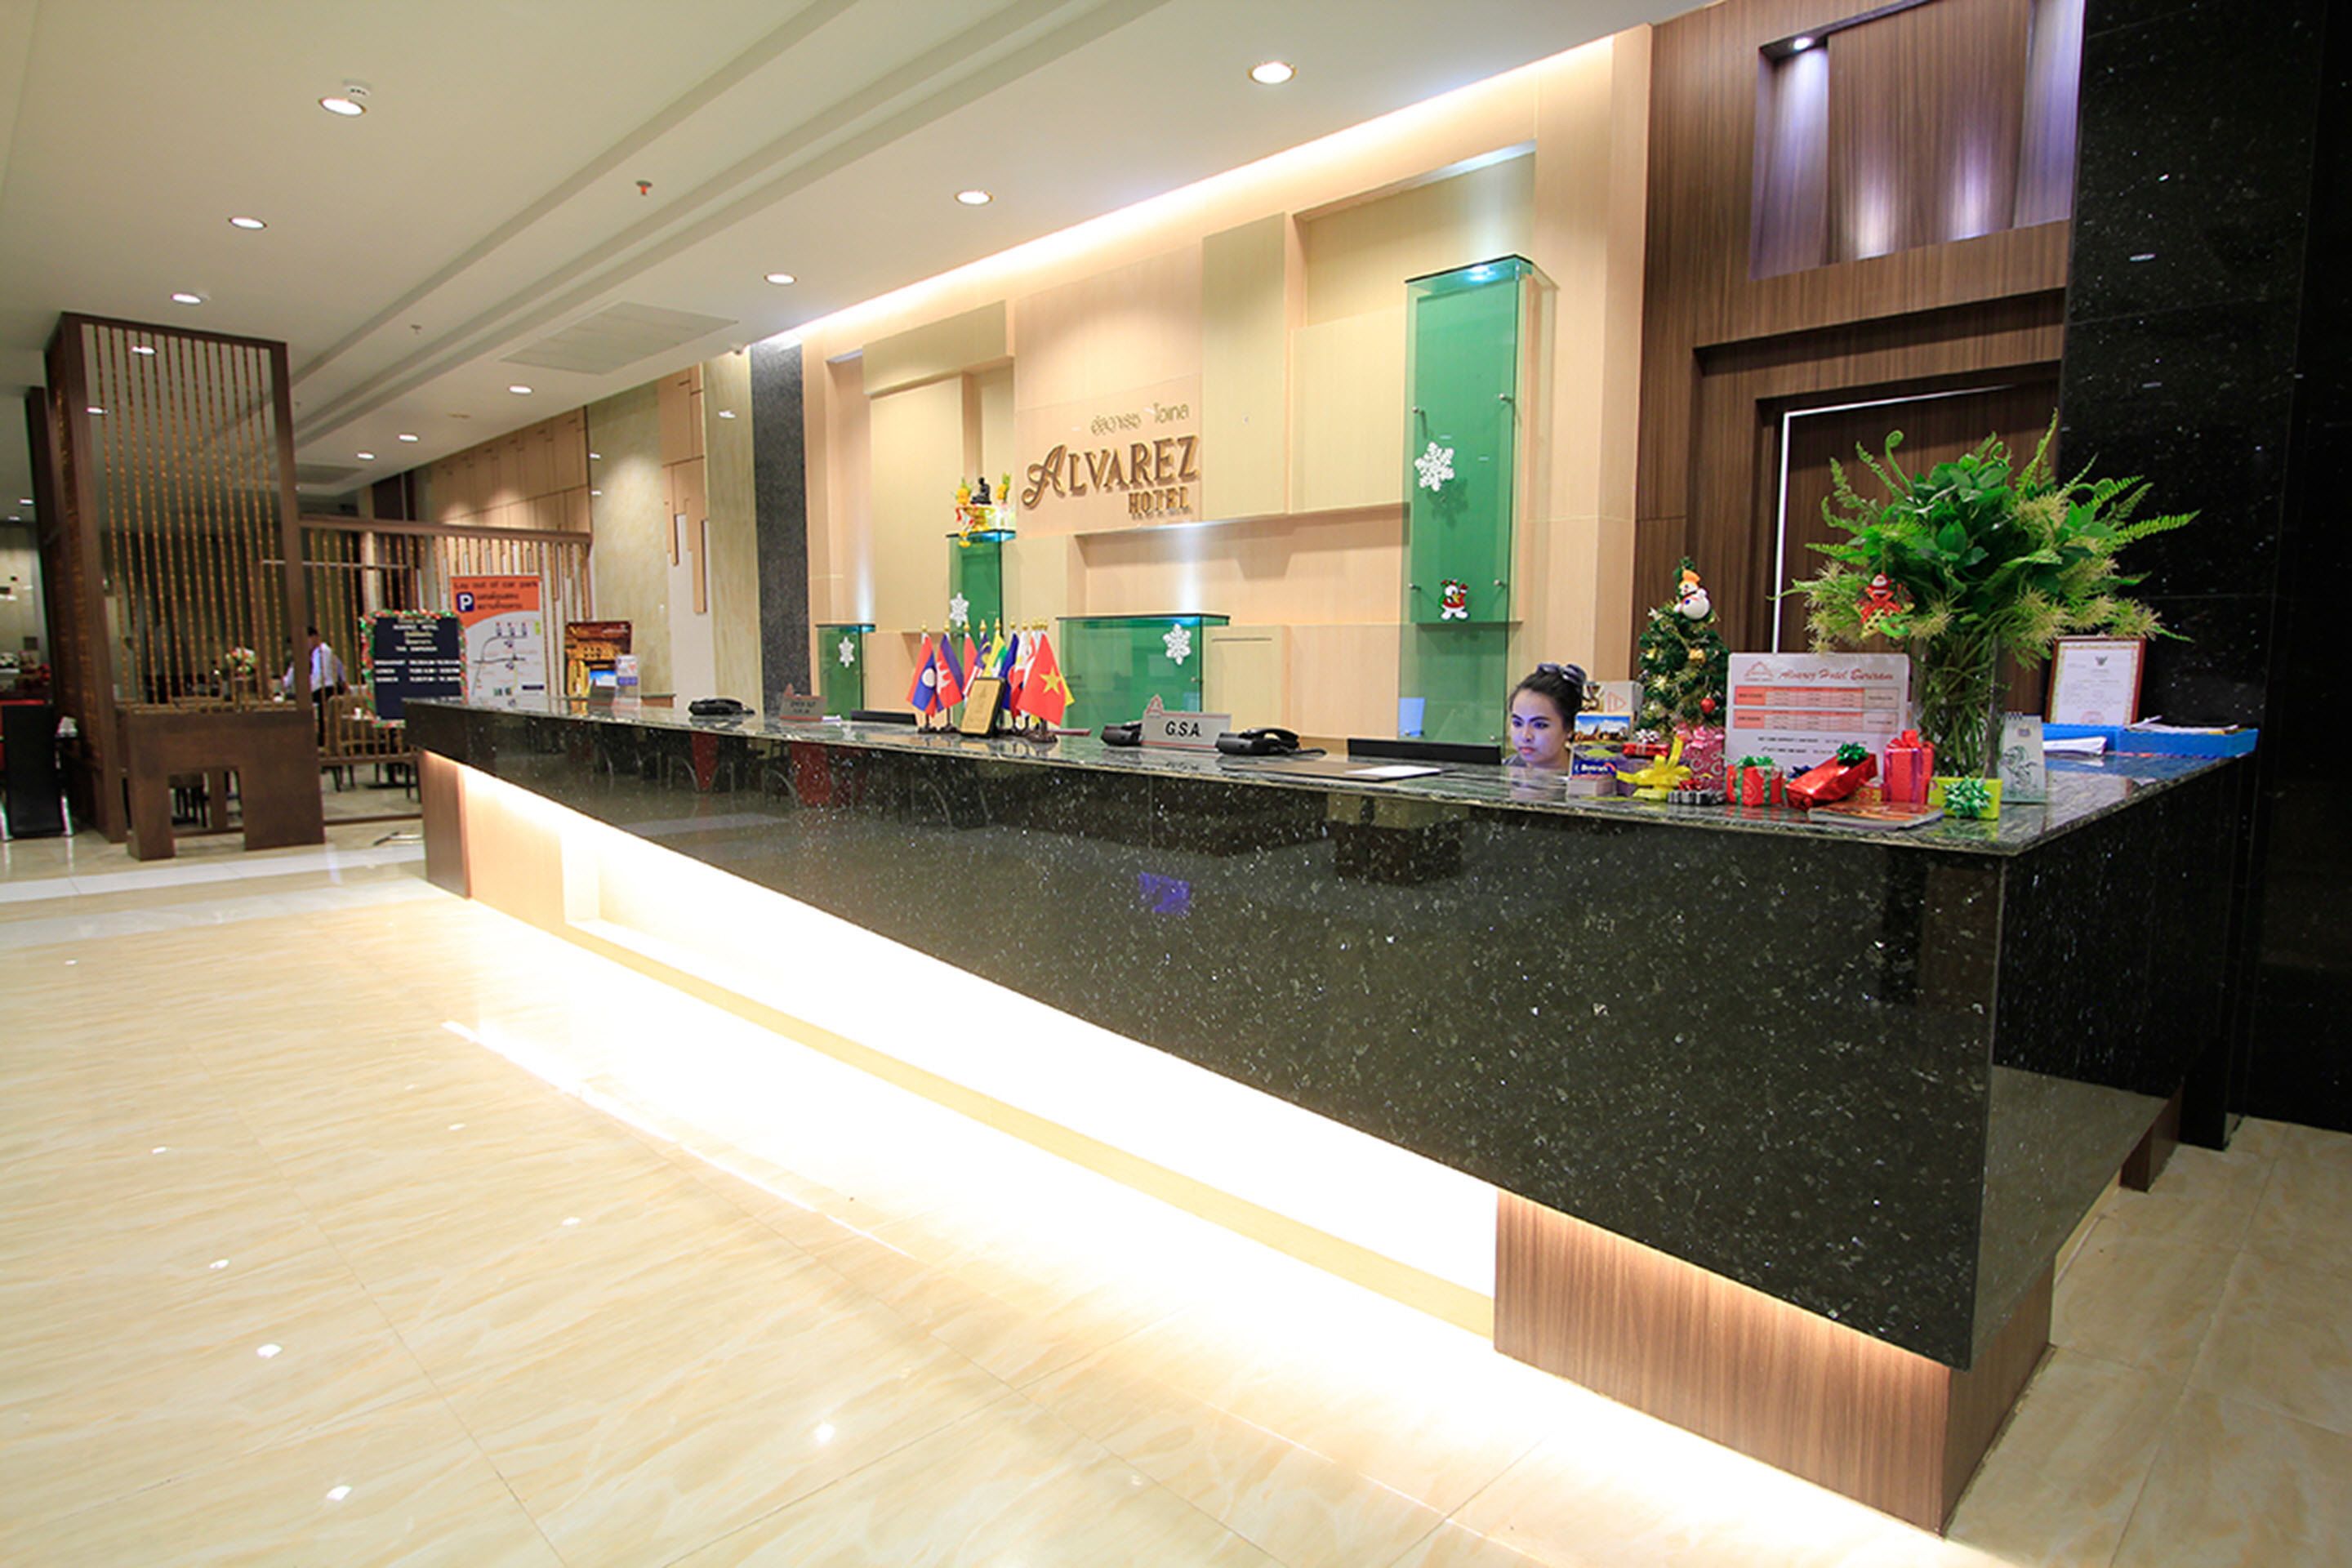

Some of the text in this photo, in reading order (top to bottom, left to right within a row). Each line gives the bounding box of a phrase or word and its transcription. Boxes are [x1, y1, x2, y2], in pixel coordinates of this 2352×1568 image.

[1021, 434, 1200, 510] ALVAREZ
[1128, 486, 1192, 516] HOTEL
[459, 595, 473, 611] P
[1818, 668, 1847, 680] Hotel
[1165, 720, 1201, 737] GSA
